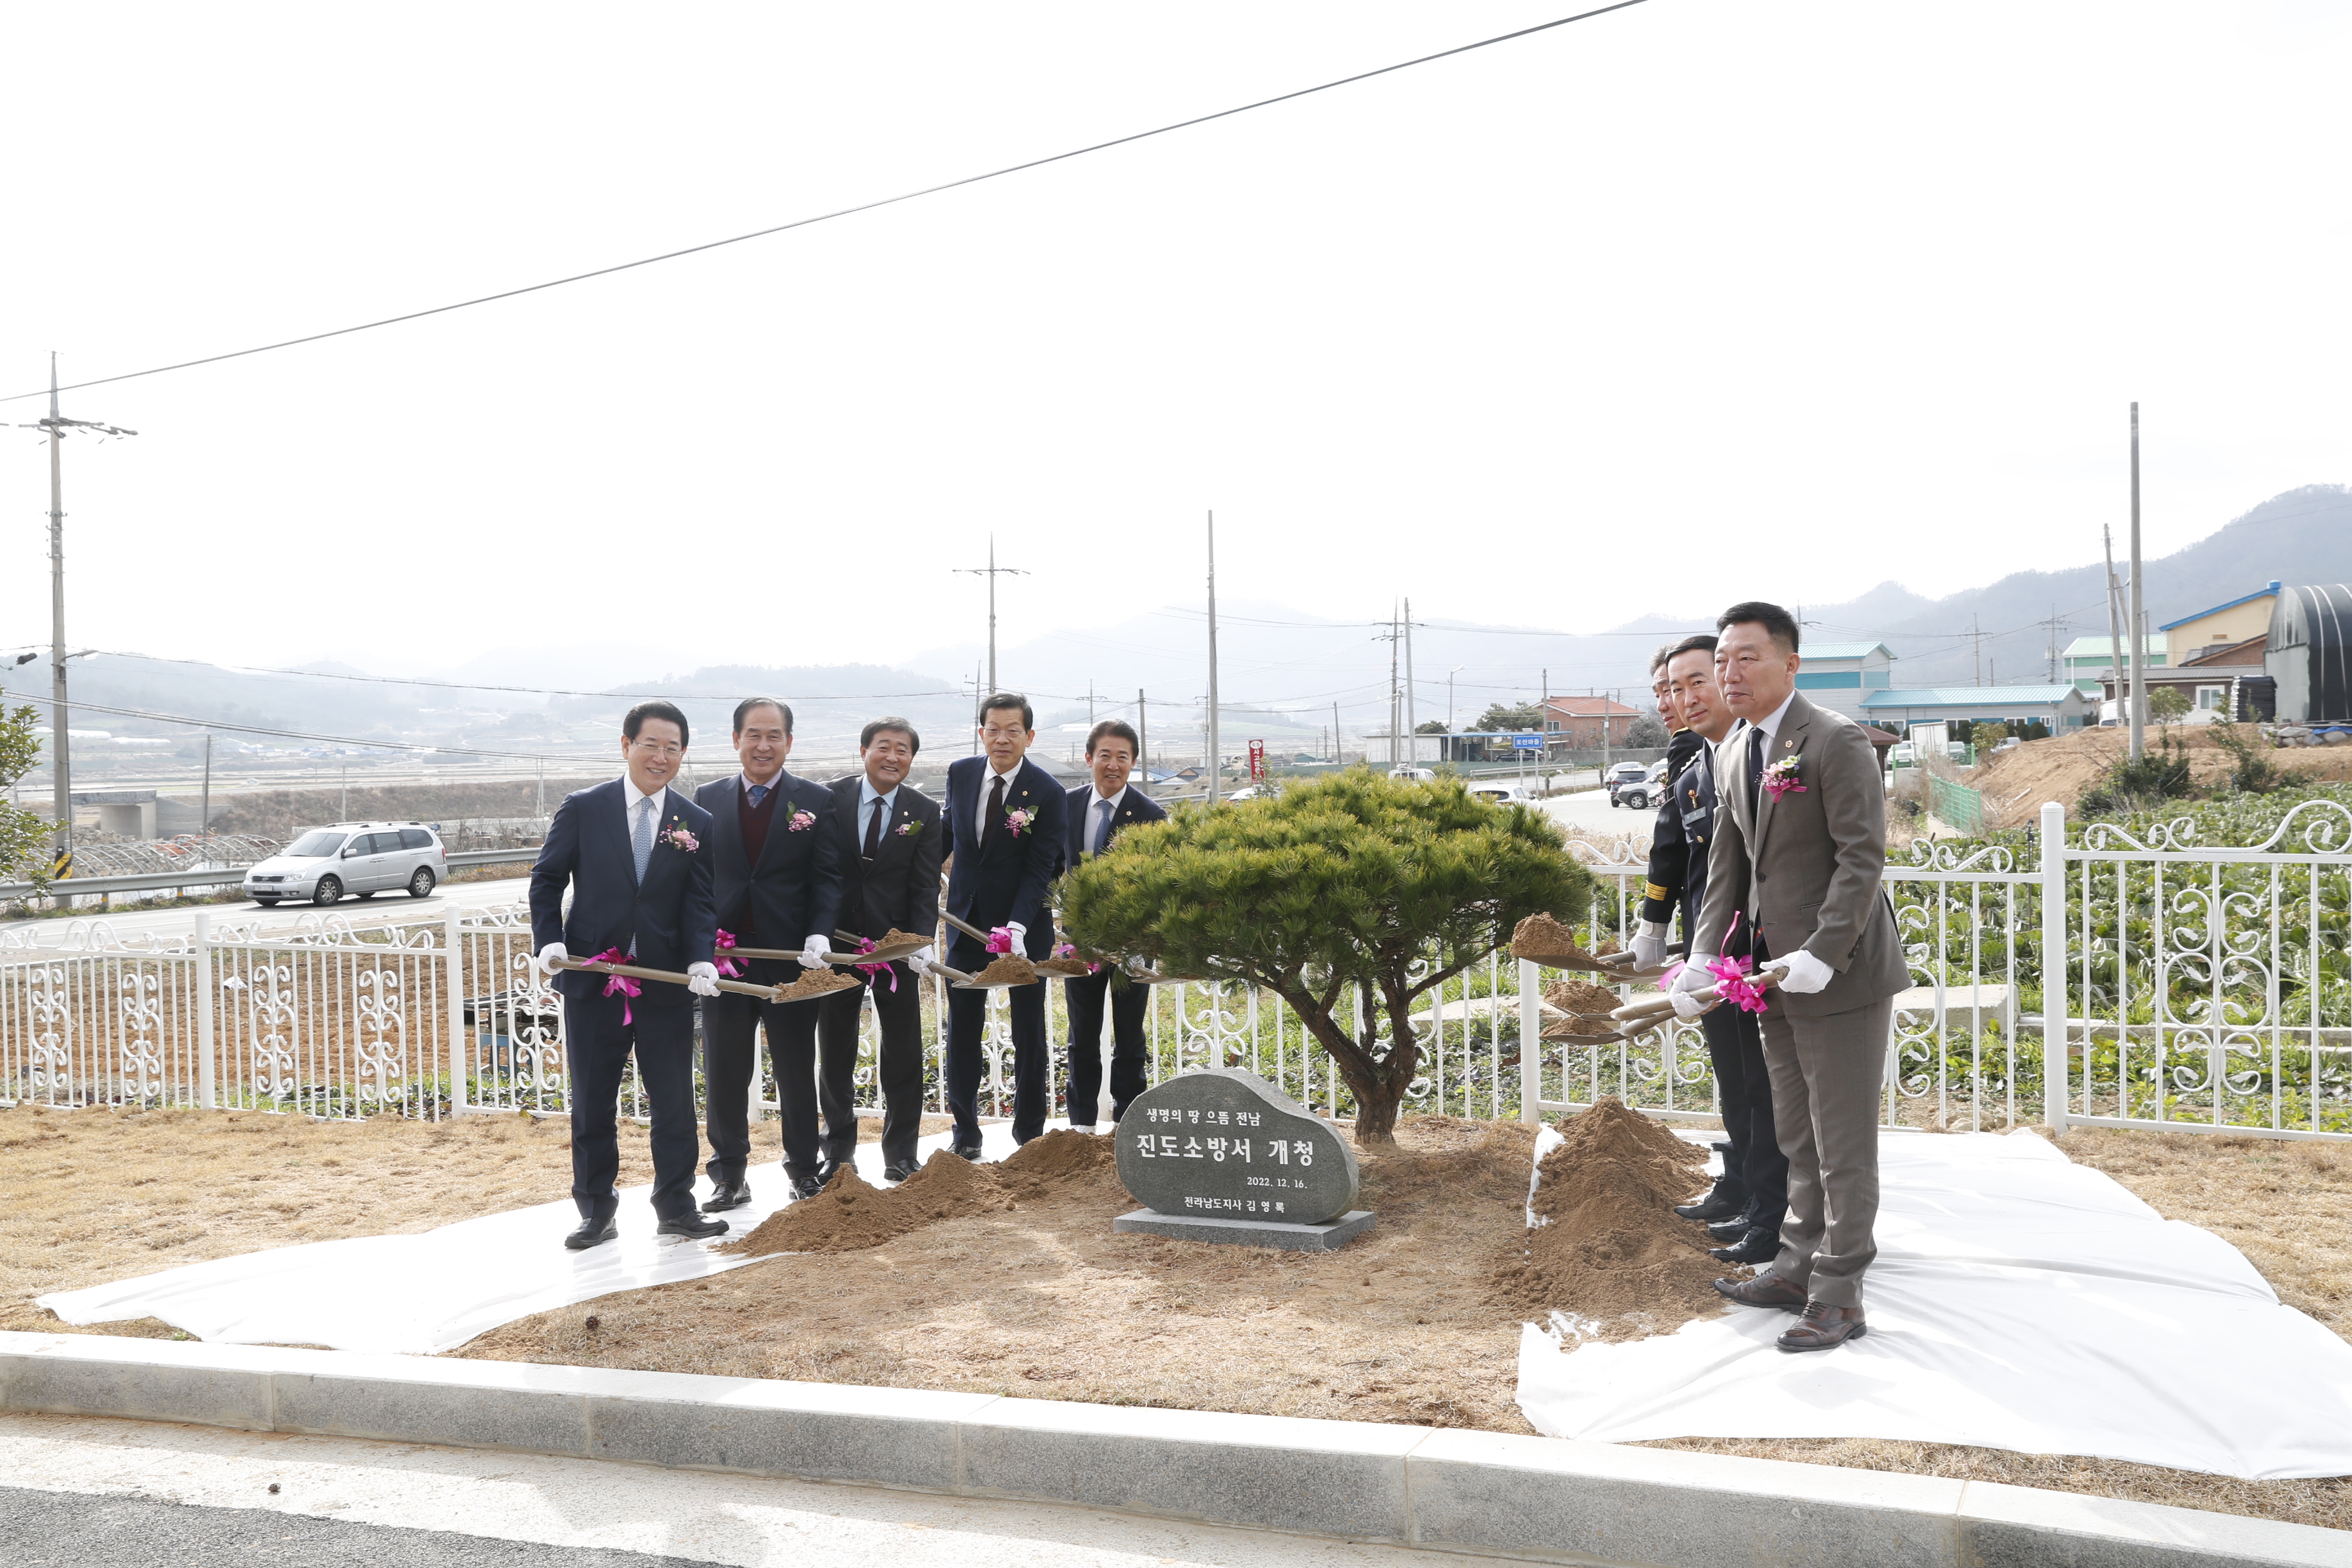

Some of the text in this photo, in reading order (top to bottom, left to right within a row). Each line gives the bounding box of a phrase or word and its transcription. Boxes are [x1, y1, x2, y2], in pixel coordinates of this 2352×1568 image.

[1253, 749, 1262, 778] 사고많은
[1147, 1108, 1261, 1126] 생명의 땅 으뜸 전남
[1137, 1134, 1313, 1166] 진도소방서 개청
[1247, 1177, 1308, 1189] 2022. 12. 16.
[1184, 1196, 1242, 1211] 전라남도지사
